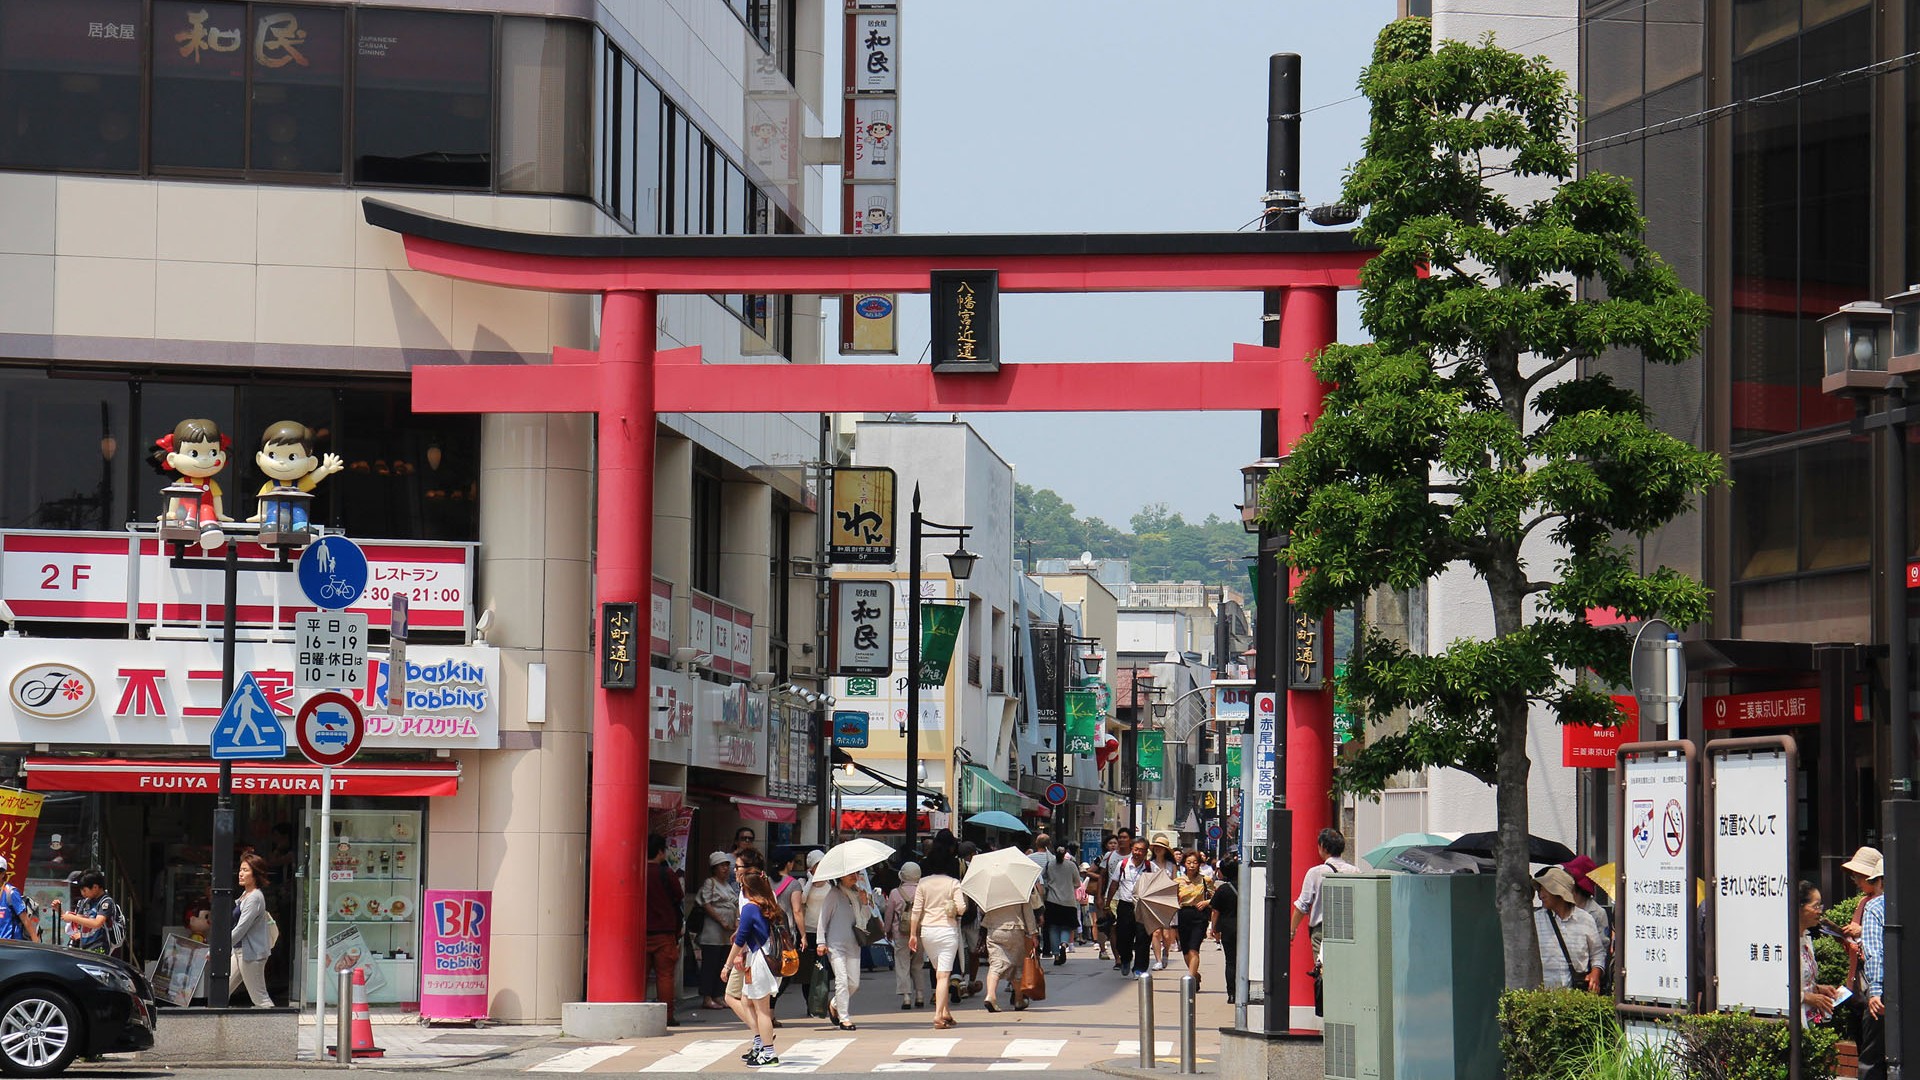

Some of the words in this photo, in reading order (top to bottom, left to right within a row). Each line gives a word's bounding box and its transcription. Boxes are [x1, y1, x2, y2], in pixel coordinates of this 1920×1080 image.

[88, 22, 136, 40] 居食屋
[175, 9, 310, 68] 和民
[864, 29, 891, 73] 和民
[856, 117, 864, 161] レストラン
[957, 281, 977, 360] 八幡宮近道
[375, 568, 438, 582] レストラン
[412, 588, 460, 602] 21:00
[855, 588, 878, 598] 居食屋
[307, 618, 358, 634] 平日の
[851, 599, 881, 650] 和民
[610, 611, 630, 681] 小町通り
[1296, 612, 1317, 681] 小町通り
[116, 668, 294, 717] 不二家
[1739, 697, 1807, 720] 三菱東京UFJ銀行
[402, 718, 477, 735] アイスクリーム
[1260, 718, 1273, 744] 赤尾
[1593, 730, 1615, 738] MUFG
[139, 776, 208, 788] FUJIYA
[216, 777, 348, 790] ESTAURAT
[1719, 814, 1777, 837] 放置なくして
[1634, 880, 1681, 895] なくそう放置自転車
[434, 900, 485, 937] BR
[1636, 902, 1678, 917] やめよう路上喫煙
[1635, 925, 1679, 940] 安全で美しいまち
[435, 941, 481, 955] baskin
[1645, 947, 1668, 962] かまくら
[1750, 943, 1783, 962] 鎌倉市
[436, 956, 482, 970] robbins
